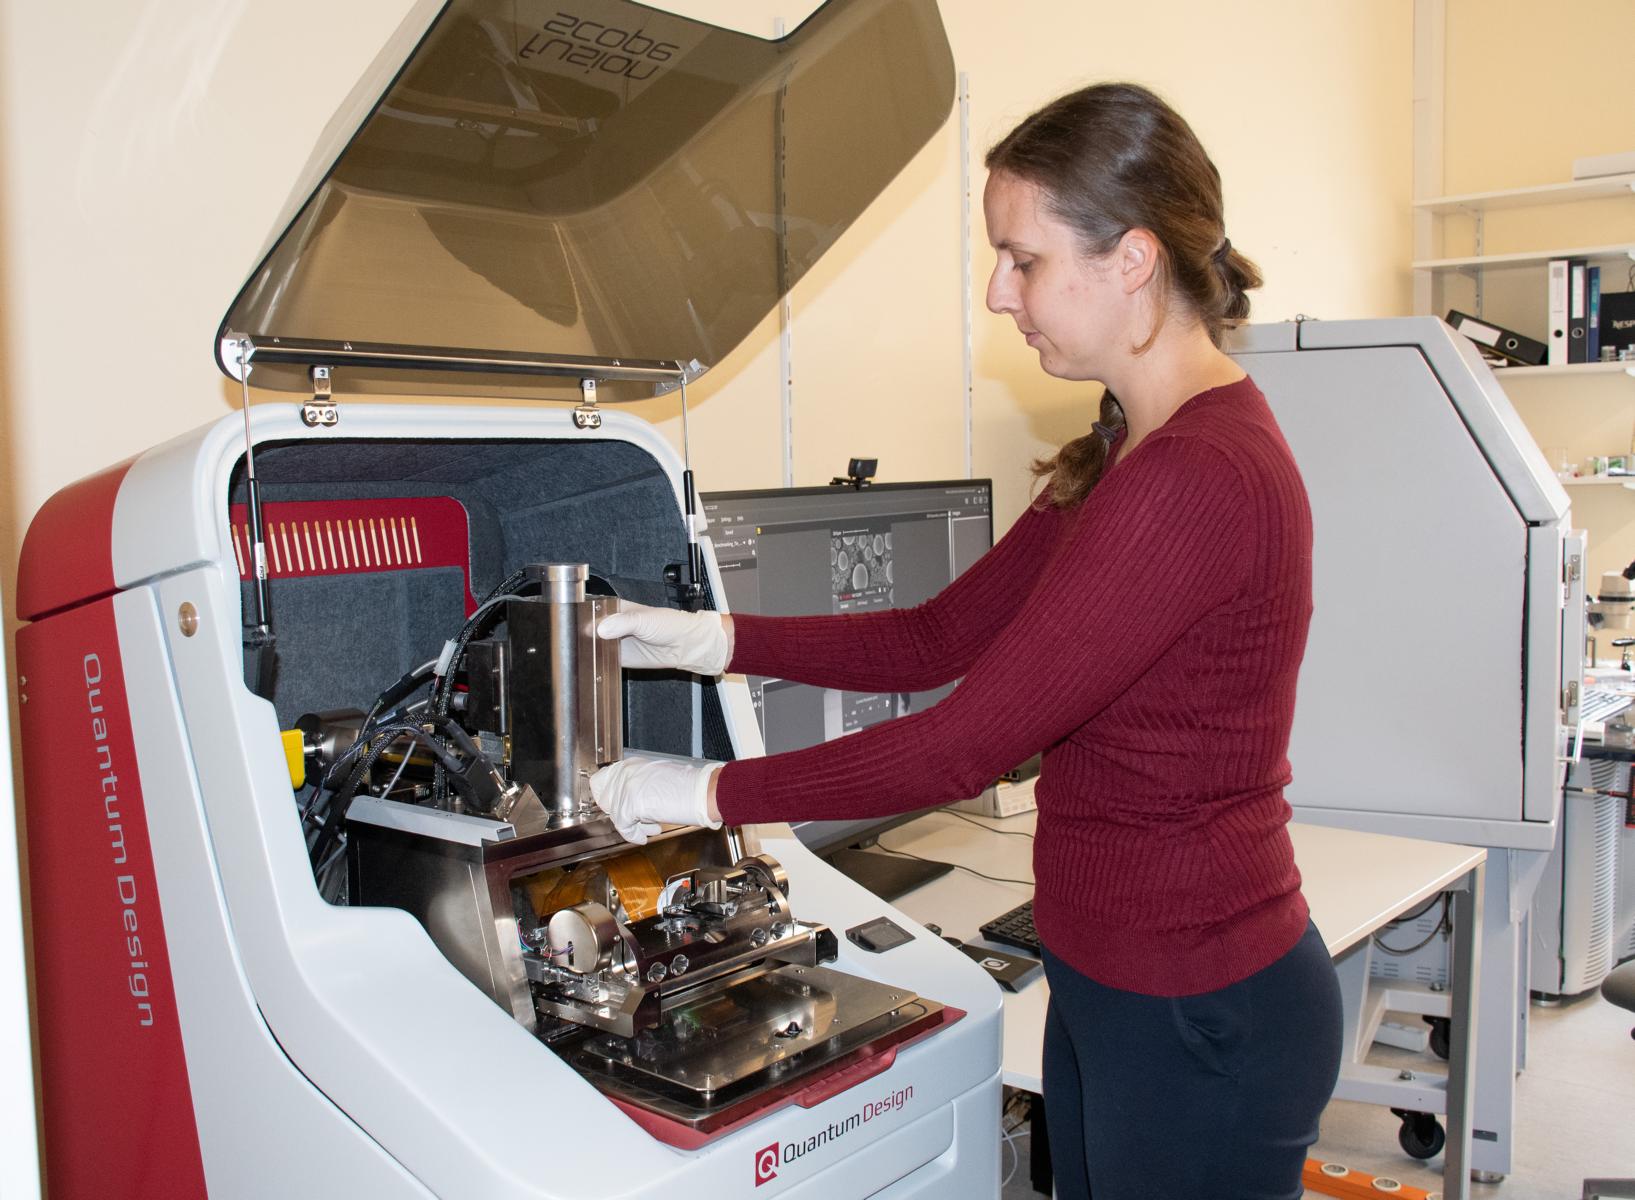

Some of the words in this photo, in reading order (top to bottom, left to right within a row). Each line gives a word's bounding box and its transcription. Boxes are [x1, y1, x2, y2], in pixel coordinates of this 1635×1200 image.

[83, 652, 127, 865] Quantum
[117, 874, 154, 1027] Design
[783, 1113, 860, 1164] Quantum
[863, 1085, 913, 1123] Design
